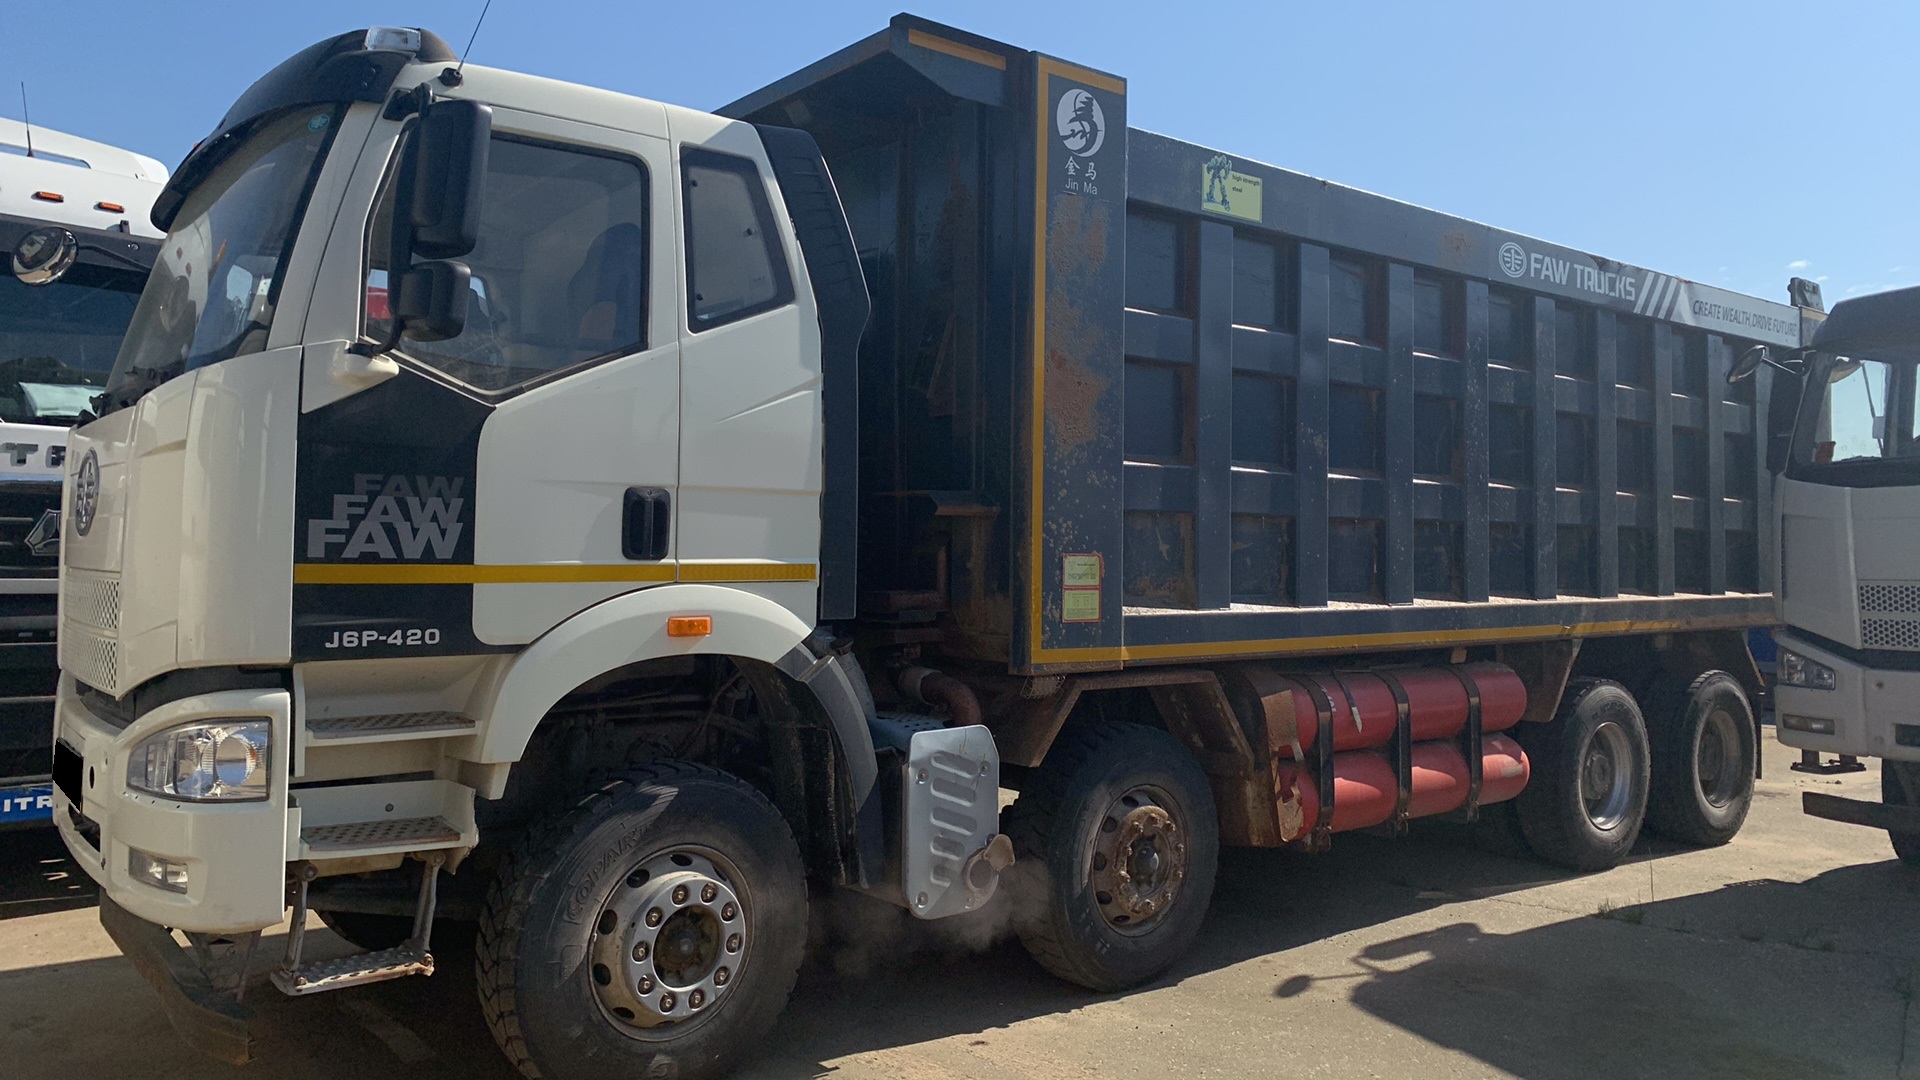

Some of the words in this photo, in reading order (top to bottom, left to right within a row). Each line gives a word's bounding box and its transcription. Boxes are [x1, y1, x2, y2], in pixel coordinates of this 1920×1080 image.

[1065, 179, 1079, 191] Jin
[1083, 182, 1098, 195] Ma
[1530, 253, 1570, 285] FAW
[1574, 264, 1636, 301] TRUCKS
[1693, 300, 1722, 320] CREATE
[1773, 318, 1798, 337] FUTURE
[353, 473, 464, 503] FAW
[333, 494, 464, 529] FAW
[307, 518, 464, 560] FAW
[325, 628, 441, 649] J6P-420
